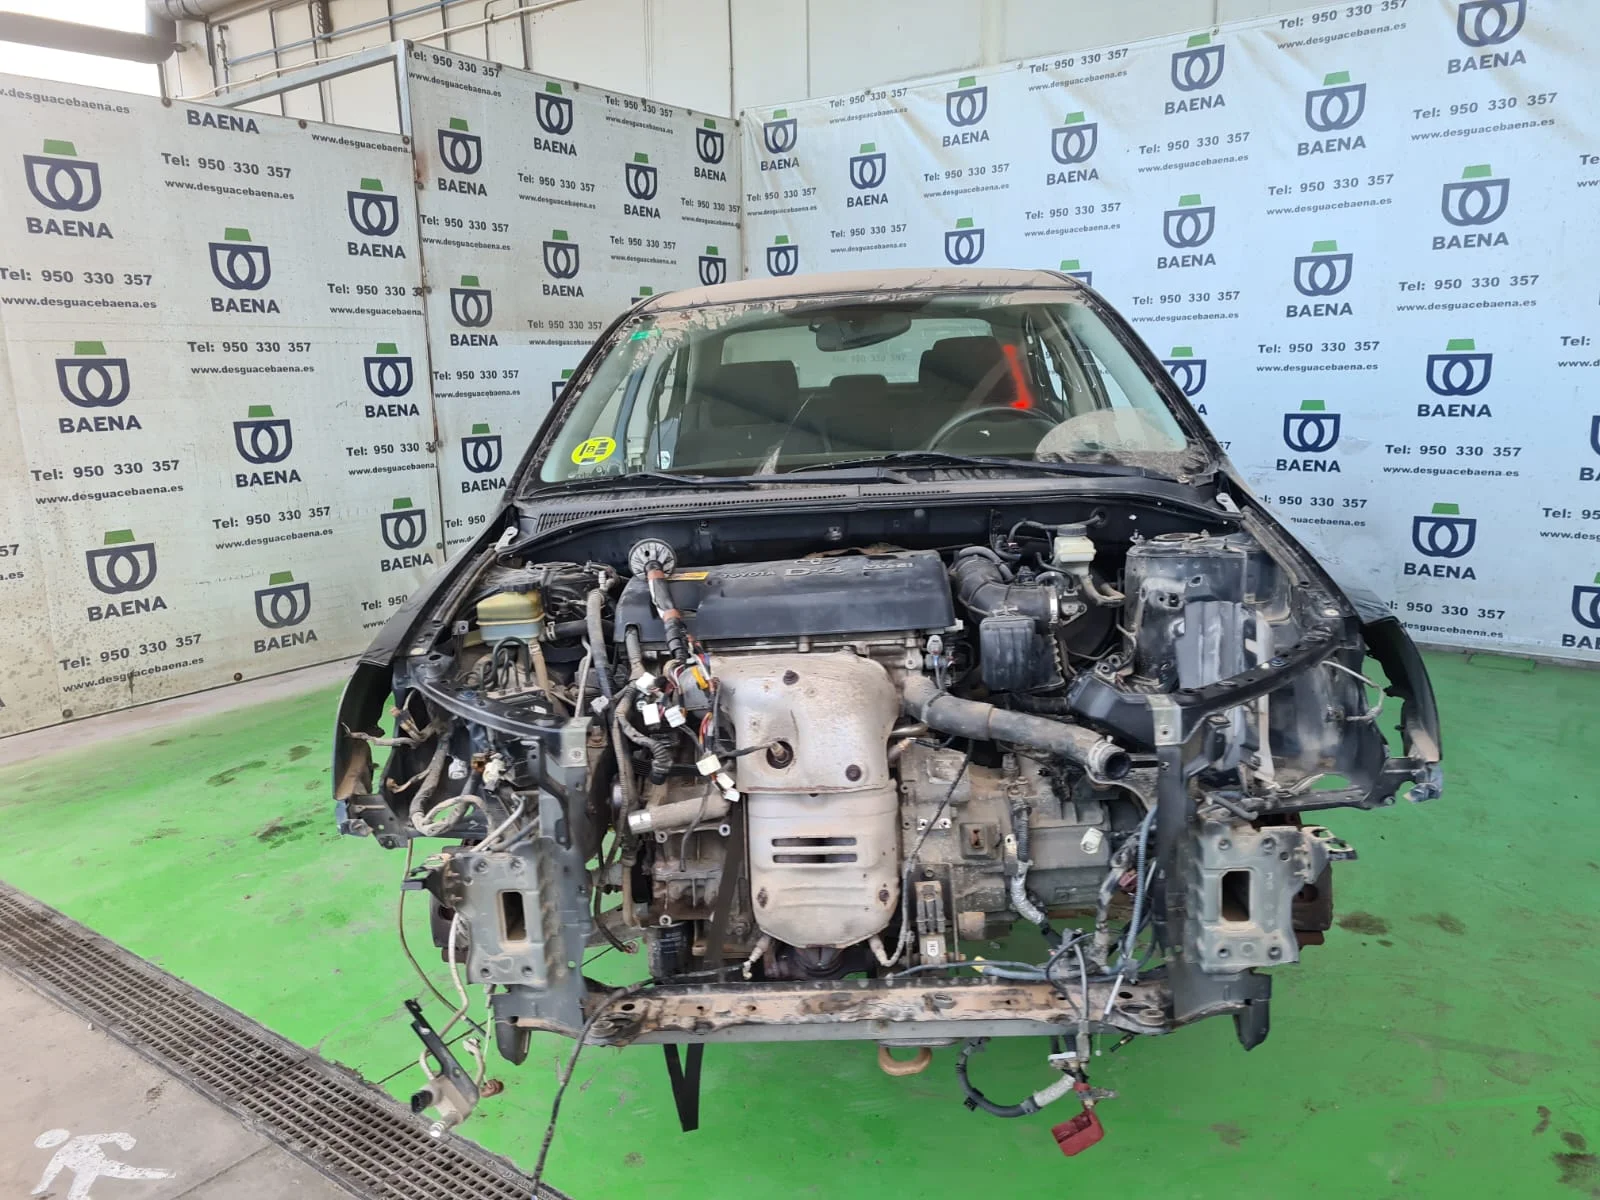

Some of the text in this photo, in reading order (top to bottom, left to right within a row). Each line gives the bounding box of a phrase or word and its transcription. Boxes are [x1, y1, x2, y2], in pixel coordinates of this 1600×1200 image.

[1279, 0, 1407, 29] Tel: 950 330 357
[1278, 22, 1406, 50] www.desguacebaena.es
[409, 51, 500, 78] Tel: 950 330 357
[1028, 48, 1129, 74] Tel: 950 330 357
[1447, 49, 1527, 74] BAENA
[1028, 71, 1126, 91] www.desguacebaena.es
[1164, 94, 1226, 115] BAENA
[1413, 92, 1558, 120] Tel: 950 330 357
[185, 107, 260, 134] BAENA
[1411, 118, 1555, 141] www.desguacebaena.es
[534, 137, 577, 156] BAENA
[942, 129, 990, 147] BAENA
[1139, 131, 1250, 155] Tel: 950 330 357
[1297, 135, 1366, 156] BAENA
[161, 152, 291, 178] Tel: 950 330 357
[761, 157, 800, 171] BAENA
[924, 163, 1010, 182] Tel: 950 330 357
[1138, 155, 1249, 173] www.desguacebaena.es
[517, 172, 595, 192] Tel: 950 330 357
[694, 166, 727, 182] BAENA
[1046, 168, 1099, 186] BAENA
[165, 178, 295, 200] www.desguacebaena.es
[438, 177, 488, 197] BAENA
[1268, 173, 1394, 196] Tel: 950 330 357
[847, 193, 888, 208] BAENA
[1266, 198, 1392, 215] www.desguacebaena.es
[624, 204, 661, 219] BAENA
[1025, 202, 1121, 220] Tel: 950 330 357
[26, 217, 114, 239] BAENA
[420, 214, 509, 232] Tel: 950 330 357
[830, 223, 907, 238] Tel: 950 330 357
[1024, 224, 1121, 237] www.desguacebaena.es
[347, 241, 406, 259] BAENA
[609, 235, 676, 250] Tel: 950 330 357
[1432, 232, 1509, 250] BAENA
[1157, 253, 1216, 269] BAENA
[0, 267, 152, 286] Tel: 950 330 357
[1398, 274, 1539, 291] Tel: 950 330 357
[542, 284, 584, 297] BAENA
[1132, 291, 1240, 305] Tel: 950 330 357
[210, 297, 280, 314] BAENA
[1286, 302, 1353, 318] BAENA
[1396, 300, 1536, 311] www.desguacebaena.es
[1131, 313, 1239, 323] www.desguacebaena.es
[186, 341, 311, 352] Tel: 950 330 357
[450, 333, 498, 346] BAENA
[1258, 341, 1380, 353] Tel: 950 330 357
[190, 365, 315, 375] www.desguacebaena.es
[433, 370, 519, 381] Tel: 950 330 357
[1256, 363, 1378, 373] www.desguacebaena.es
[365, 403, 420, 418] BAENA
[1417, 404, 1492, 417] BAENA
[58, 415, 142, 434] BAENA
[1385, 444, 1522, 457] Tel: 950 330 357
[30, 459, 180, 481] Tel: 950 330 357
[1276, 459, 1341, 473] BAENA
[235, 469, 302, 488] BAENA
[461, 477, 507, 494] BAENA
[35, 485, 184, 505] www.desguacebaena.es
[1279, 495, 1367, 508] 950 330 357
[212, 506, 330, 529] Tel: 950 330 357
[216, 528, 333, 550] www.desguacebaena.es
[380, 553, 434, 572] BAENA
[1404, 562, 1476, 580] BAENA
[87, 596, 168, 622] BAENA
[1406, 602, 1505, 620] 950 330 357
[254, 629, 318, 654] BAENA
[58, 633, 202, 671] Tel: 950 330 357
